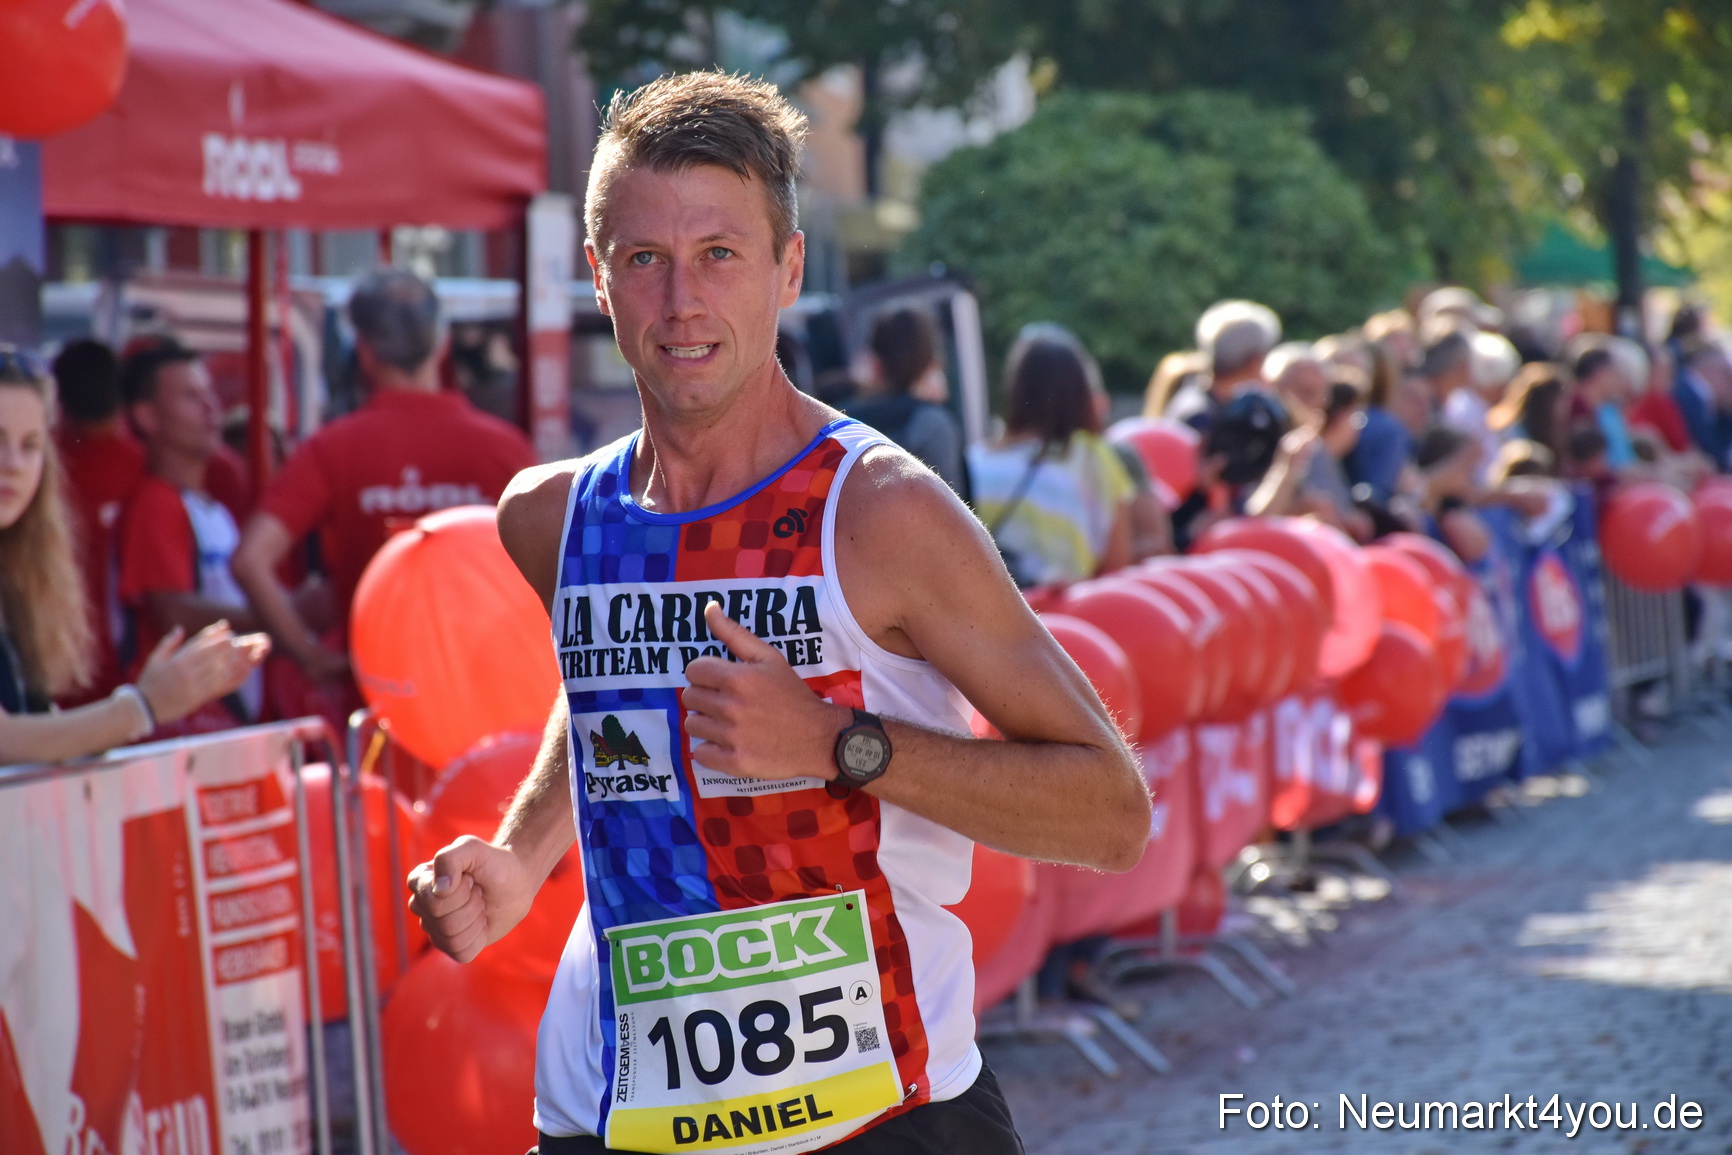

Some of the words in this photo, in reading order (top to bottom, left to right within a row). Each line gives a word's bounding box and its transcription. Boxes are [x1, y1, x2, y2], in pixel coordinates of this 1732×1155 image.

[560, 596, 594, 648] LA
[607, 585, 823, 644] CARRERA
[560, 646, 670, 680] TRITEAM
[584, 771, 672, 799] Pyraser
[701, 777, 754, 786] INNOVATIVE
[736, 779, 807, 793] AKTIENGESELLSCHAFT
[624, 909, 838, 990] BOCK
[855, 986, 868, 1001] A
[647, 985, 850, 1090] 1085
[672, 1093, 834, 1145] DANIEL
